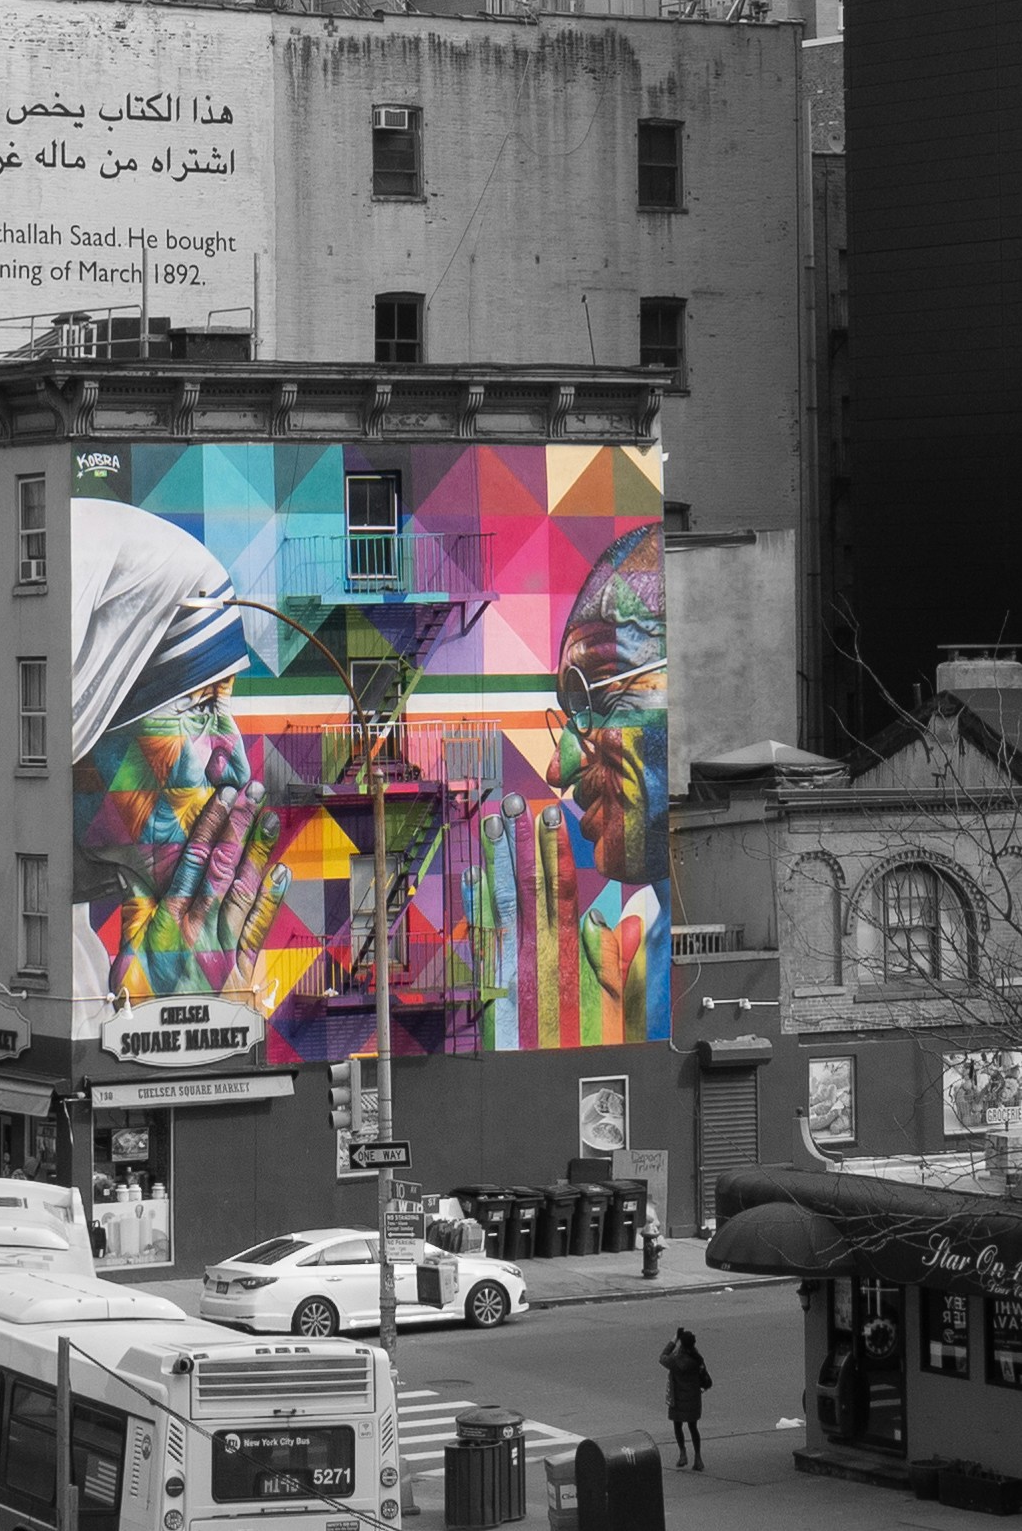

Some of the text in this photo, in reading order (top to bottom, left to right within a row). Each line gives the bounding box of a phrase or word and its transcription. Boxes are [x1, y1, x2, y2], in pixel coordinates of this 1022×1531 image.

[6, 91, 85, 129] يخص
[98, 91, 180, 132] الكتاب
[193, 95, 233, 124] هذا
[35, 139, 86, 169] ماله
[99, 149, 138, 179] من
[151, 146, 235, 182] اشتراه
[70, 225, 122, 248] Saad.
[129, 228, 158, 249] He
[166, 229, 237, 258] bought
[50, 261, 73, 280] of
[79, 261, 142, 283] March
[154, 263, 206, 286] 1892.
[77, 453, 120, 469] KOBRA
[160, 1005, 210, 1026] CHELSEA
[121, 1026, 250, 1056] SQUARE MARKET
[138, 1082, 250, 1100] CHELSEA SQUARE MARKET
[358, 1150, 402, 1162] ONE WAY
[396, 1183, 405, 1199] 10
[398, 1201, 408, 1213] W
[427, 1198, 436, 1207] ST
[921, 1233, 971, 1271] Star
[976, 1244, 1006, 1279] On
[243, 1437, 310, 1447] New York City Bus
[313, 1468, 351, 1485] 5271
